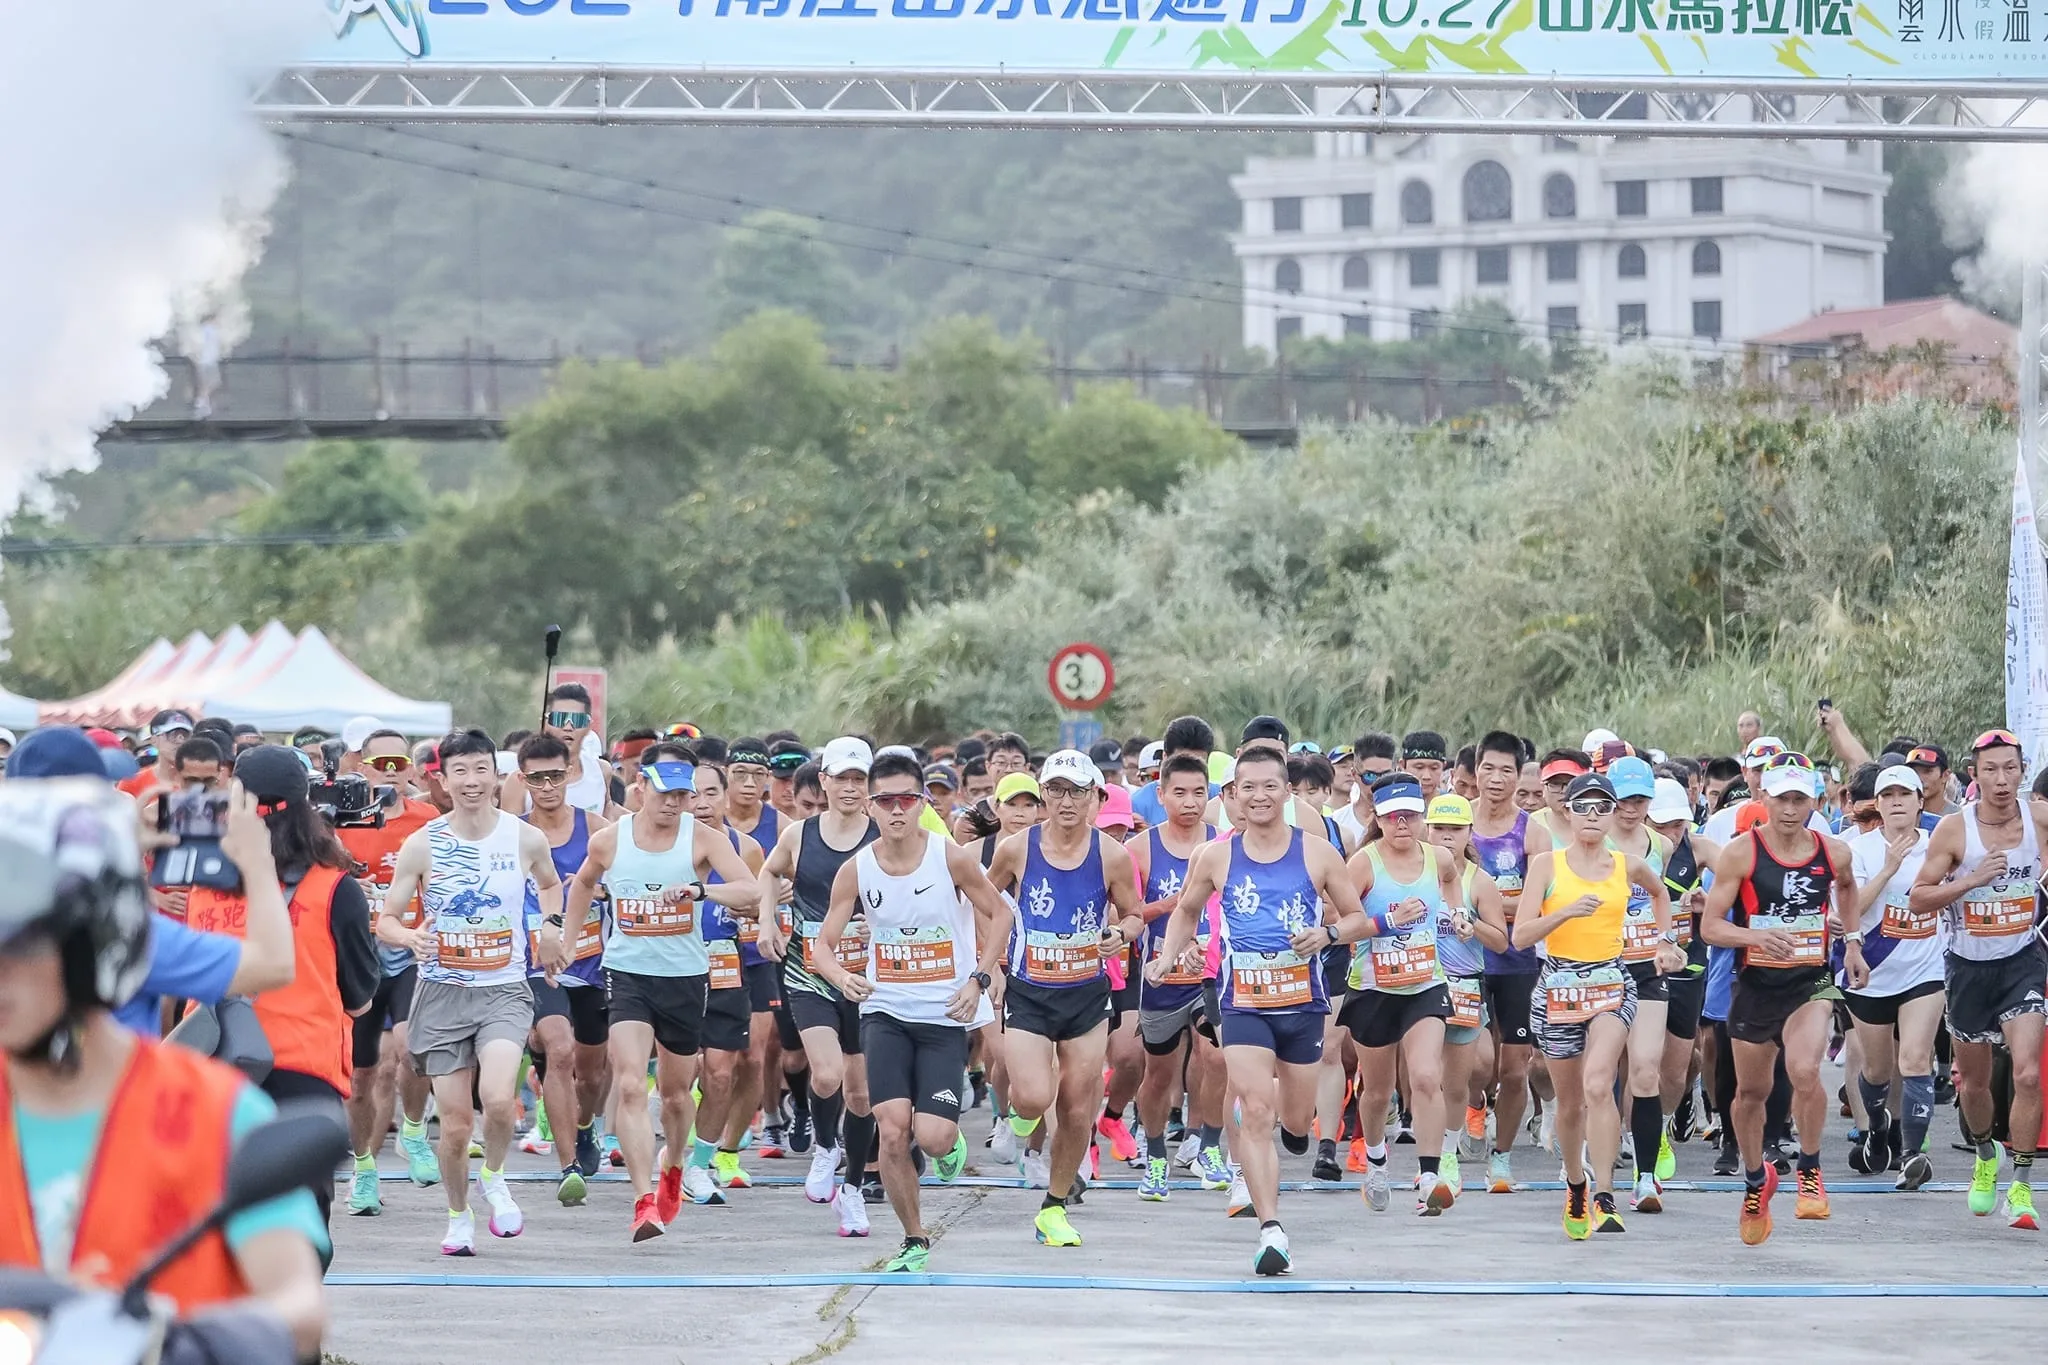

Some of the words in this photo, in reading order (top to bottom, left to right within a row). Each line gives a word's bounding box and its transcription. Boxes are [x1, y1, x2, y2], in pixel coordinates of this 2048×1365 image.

[1434, 805, 1461, 814] HOKA
[441, 932, 476, 949] 1045
[879, 944, 912, 961] 1303
[1030, 946, 1065, 962] 1040
[1238, 969, 1272, 985] 1019
